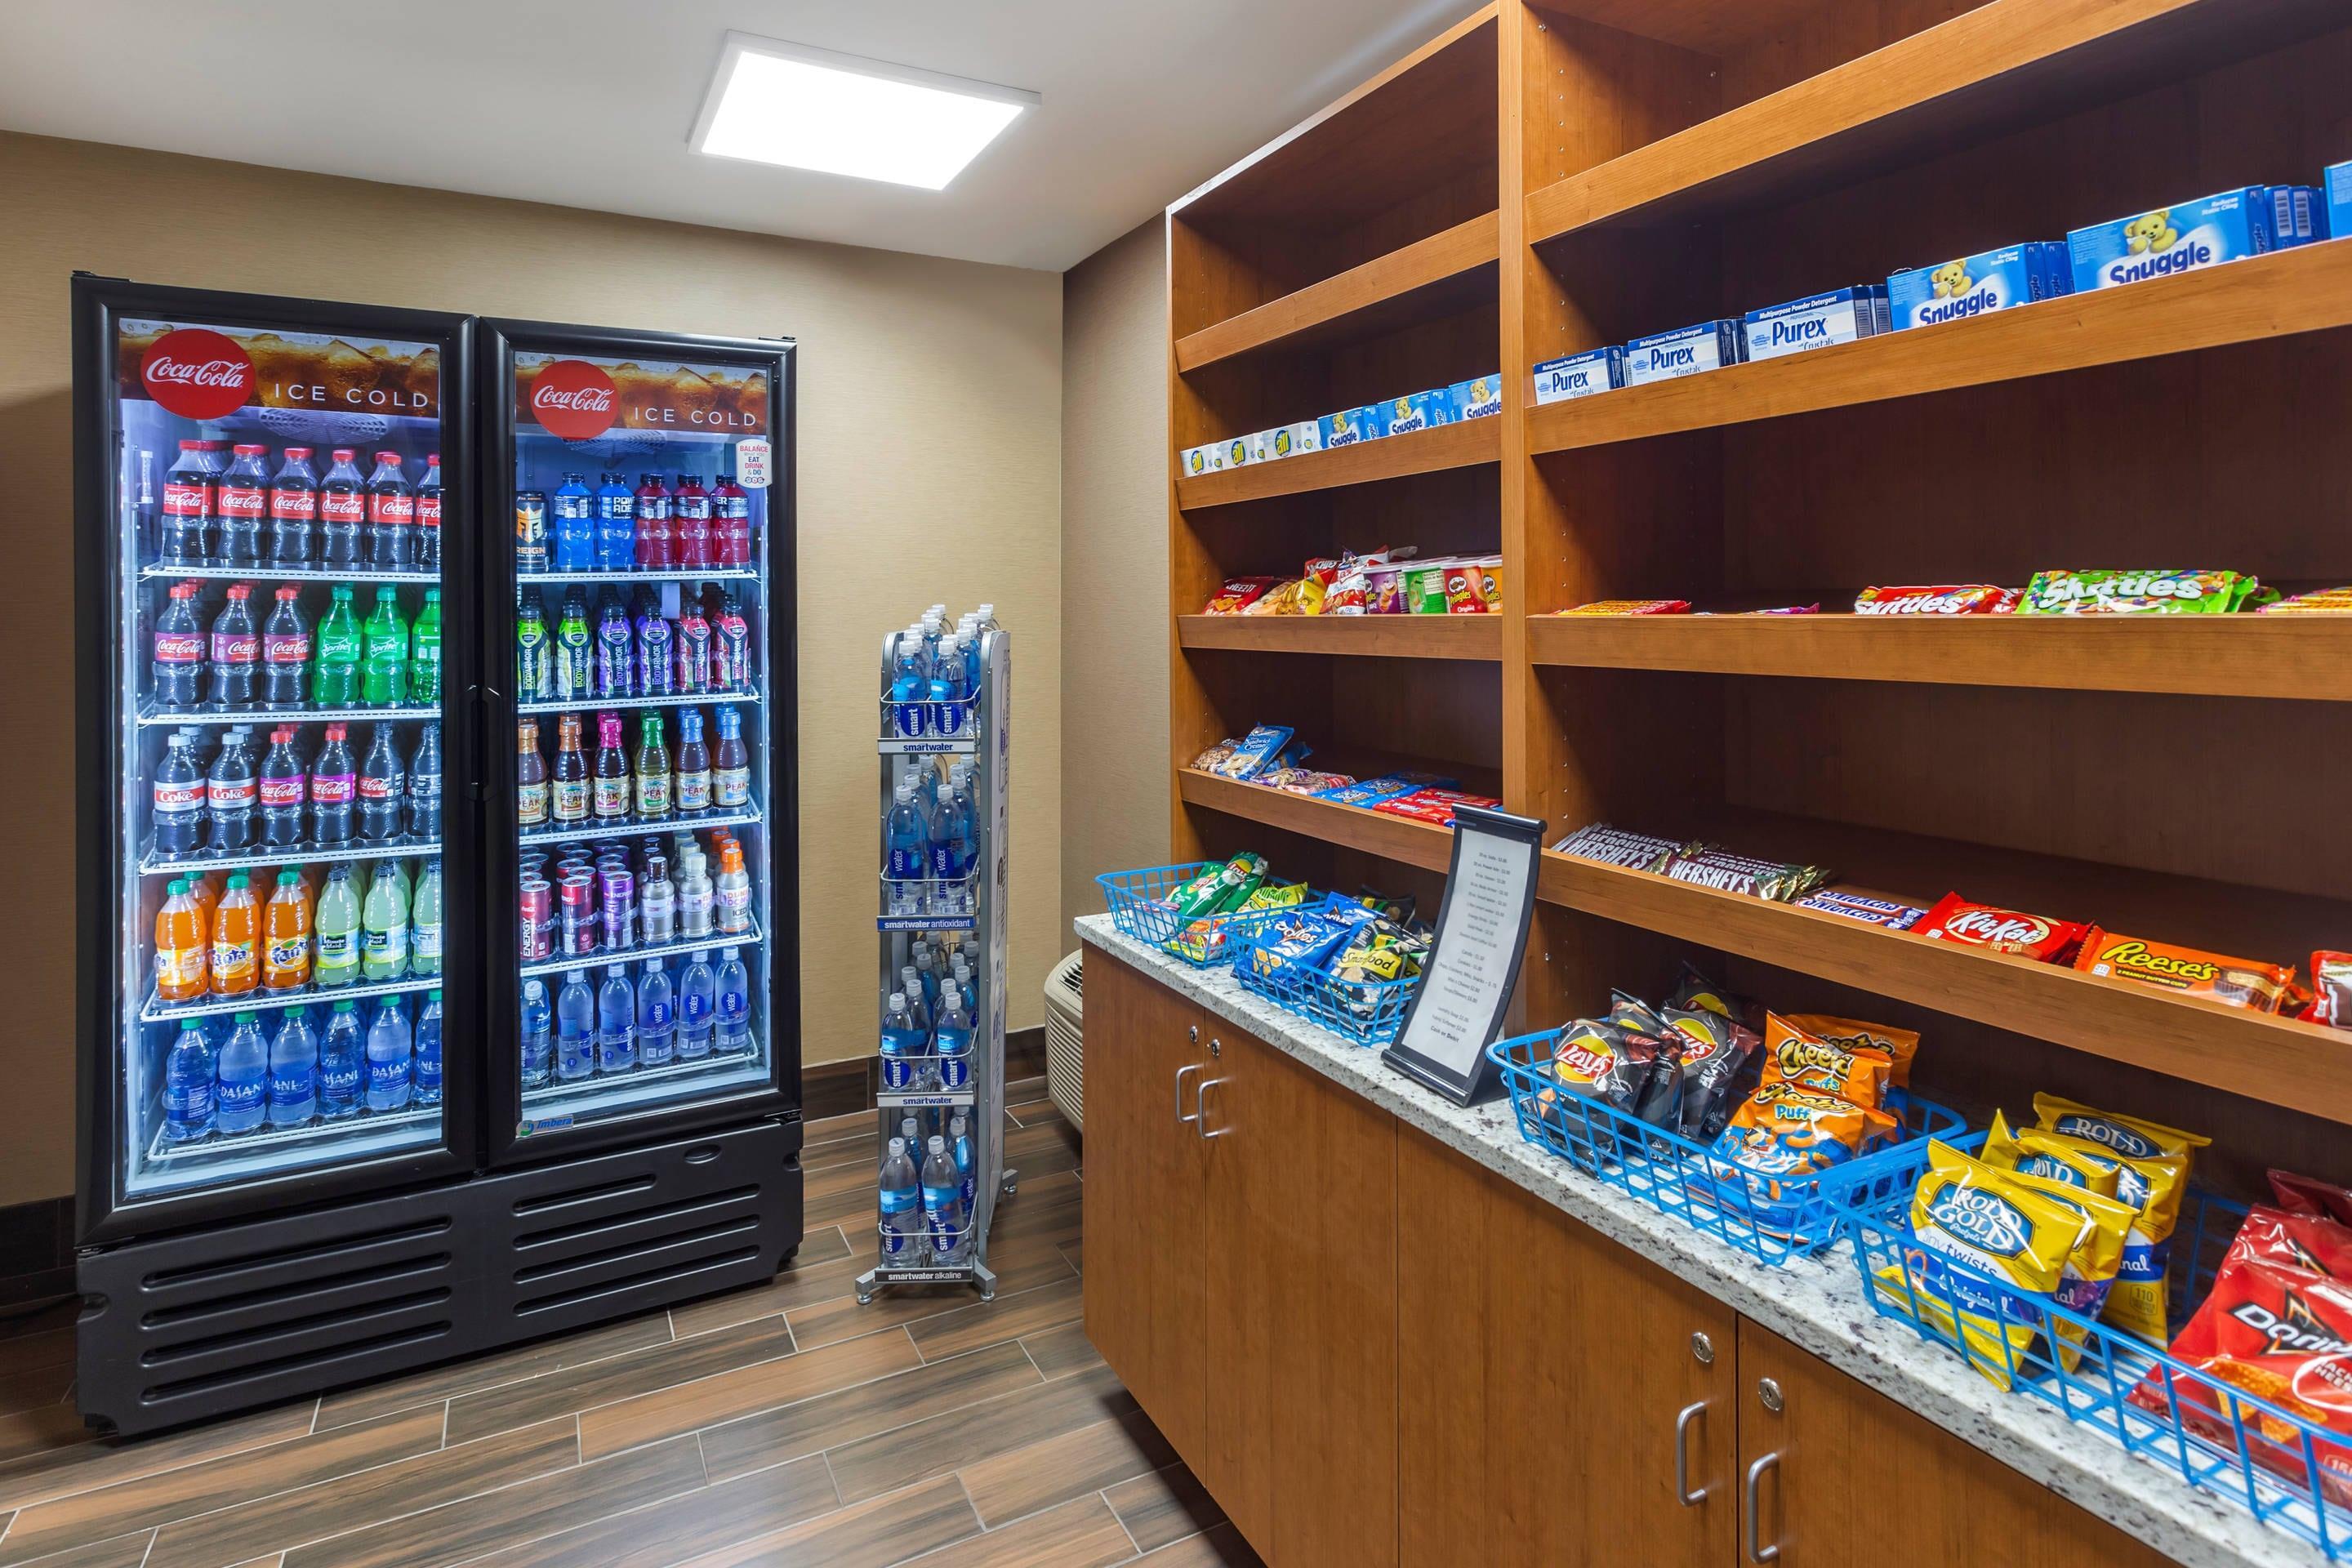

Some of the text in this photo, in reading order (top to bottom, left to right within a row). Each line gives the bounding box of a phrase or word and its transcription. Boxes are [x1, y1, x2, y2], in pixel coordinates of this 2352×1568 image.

[2110, 242, 2210, 284] Snuggle
[1791, 302, 1811, 312] Powder
[1811, 296, 1837, 307] Detergent
[1919, 288, 1998, 325] Snuggle
[1682, 328, 1703, 338] Detergent
[1772, 318, 1828, 346] Purex
[1650, 346, 1695, 371] Purex
[145, 355, 251, 389] Coca-Cola
[1552, 371, 1589, 393] Purex
[274, 383, 430, 408] ICE COLD
[534, 385, 615, 412] Coca-Cola
[635, 408, 757, 426] ICE COLD
[1467, 398, 1502, 419] Snuggle
[1392, 416, 1423, 434] Snuggle
[1276, 431, 1289, 454] all
[1330, 430, 1357, 448] Snuggle
[1192, 452, 1203, 471] all
[1232, 441, 1244, 463] all
[222, 493, 264, 510] Coca-Cola
[274, 496, 314, 512] Coca-Cola
[322, 500, 362, 514] Coca-Cola
[1450, 590, 1472, 606] Pringles
[2039, 575, 2203, 608] Skittles
[1854, 595, 1963, 614] Skittles
[157, 639, 201, 654] Coca-Cola
[323, 642, 351, 653] Sprite
[371, 642, 399, 653] Sprite
[524, 648, 533, 690] BODYARMOR
[575, 647, 583, 688] BODYARMOR
[616, 646, 624, 687] BODYARMOR
[653, 644, 662, 685] BODYARMOR
[908, 708, 920, 736] smart
[943, 706, 952, 733] smart
[903, 743, 954, 751] smartwater
[160, 790, 194, 803] Coke
[213, 789, 246, 800] Coke
[895, 849, 903, 871] water
[938, 849, 946, 871] water
[1566, 838, 1657, 870] HERSHEY'S
[1669, 859, 1756, 896] HERSHEY'S
[895, 881, 903, 900] sma
[733, 907, 747, 916] ICED
[884, 920, 970, 929] smartwater antioxidant
[523, 917, 531, 956] ENERGY
[270, 941, 309, 965] Fanta
[1342, 951, 1395, 970] Smartfood
[2100, 941, 2221, 982] Reese's
[2122, 969, 2146, 980] PEANUT
[2146, 974, 2171, 985] BUTTER
[2171, 979, 2188, 988] CUPS
[690, 995, 699, 1015] water
[725, 993, 735, 1012] water
[653, 1004, 663, 1023] water
[1557, 1045, 1612, 1074] Lay's
[893, 1059, 901, 1088] smart
[950, 1058, 958, 1086] smart
[220, 1080, 265, 1098] DASANI
[902, 1097, 953, 1105] smartwater
[1775, 1104, 1810, 1119] Puff
[537, 1116, 572, 1129] Imbera
[2074, 1117, 2148, 1157] ROLD
[1954, 1189, 2022, 1231] ROLD
[938, 1223, 948, 1251] smart
[1933, 1204, 2015, 1250] GOLD
[1946, 1243, 1998, 1277] twists
[889, 1272, 962, 1281] smartwater alkaline
[2136, 1285, 2154, 1303] 110
